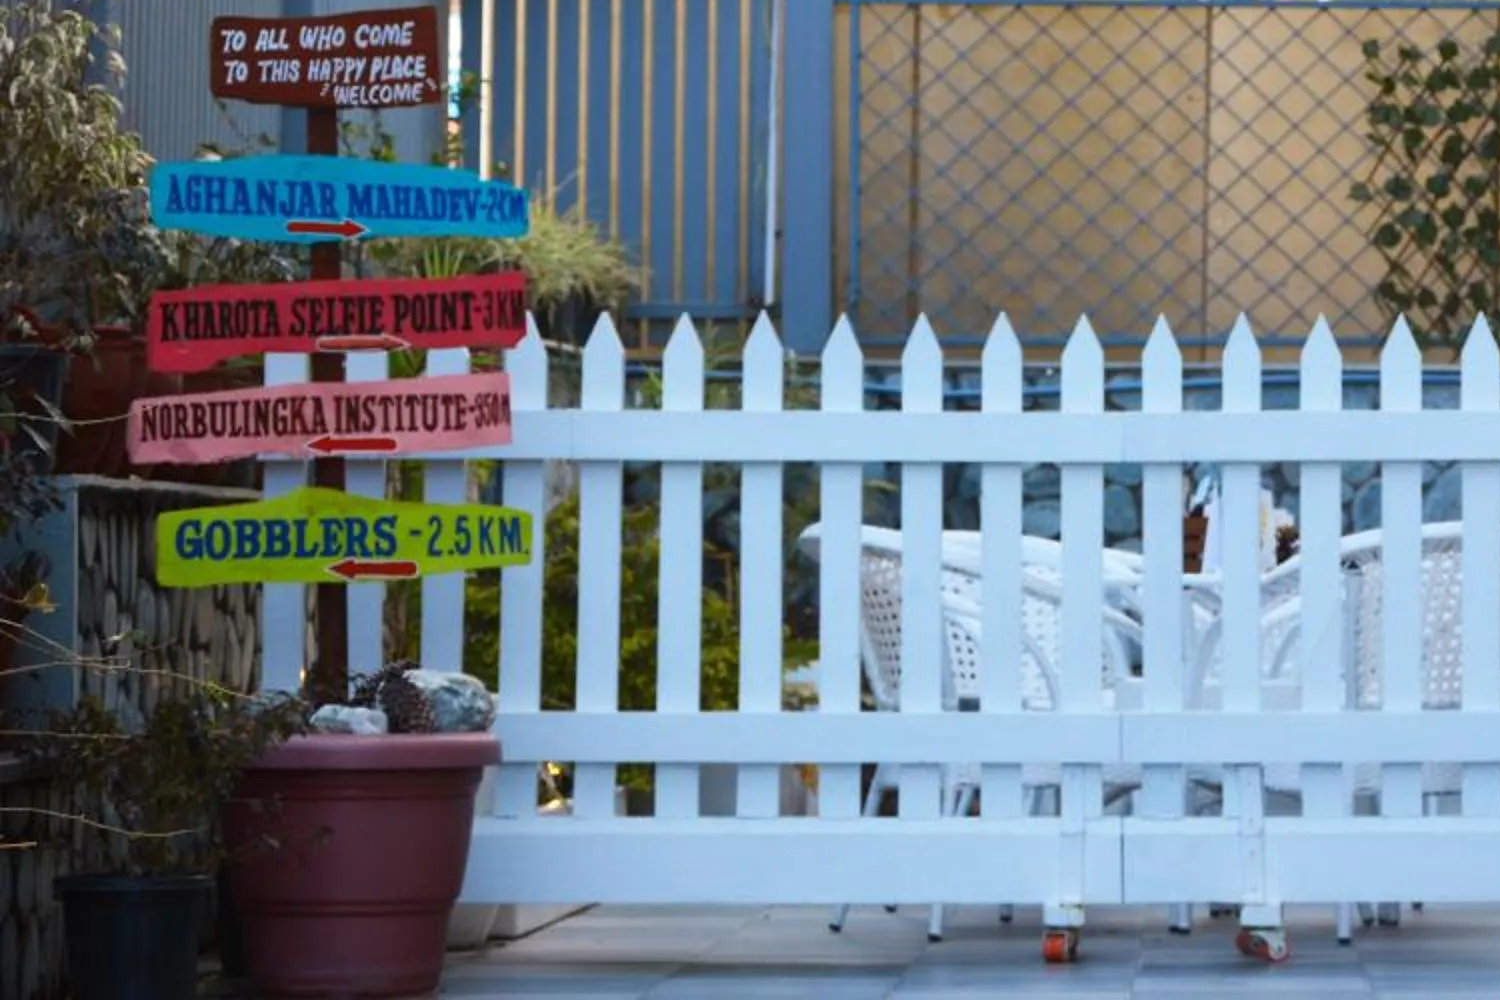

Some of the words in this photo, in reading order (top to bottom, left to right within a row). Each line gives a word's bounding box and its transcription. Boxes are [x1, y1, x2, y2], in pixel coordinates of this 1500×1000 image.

[221, 29, 248, 53] TO
[256, 28, 289, 52] ALL
[300, 25, 346, 51] WHO
[355, 21, 415, 48] COME
[224, 60, 248, 84] TO
[258, 58, 300, 83] THIS
[308, 56, 366, 84] HAPPY
[370, 55, 426, 83] PLACE
[165, 173, 339, 218] AGHANJAR
[160, 299, 282, 343] KHAROTA
[289, 295, 384, 338] SELFIE
[141, 396, 327, 442] NORBULINGKA
[175, 515, 398, 561] GOBBLERS
